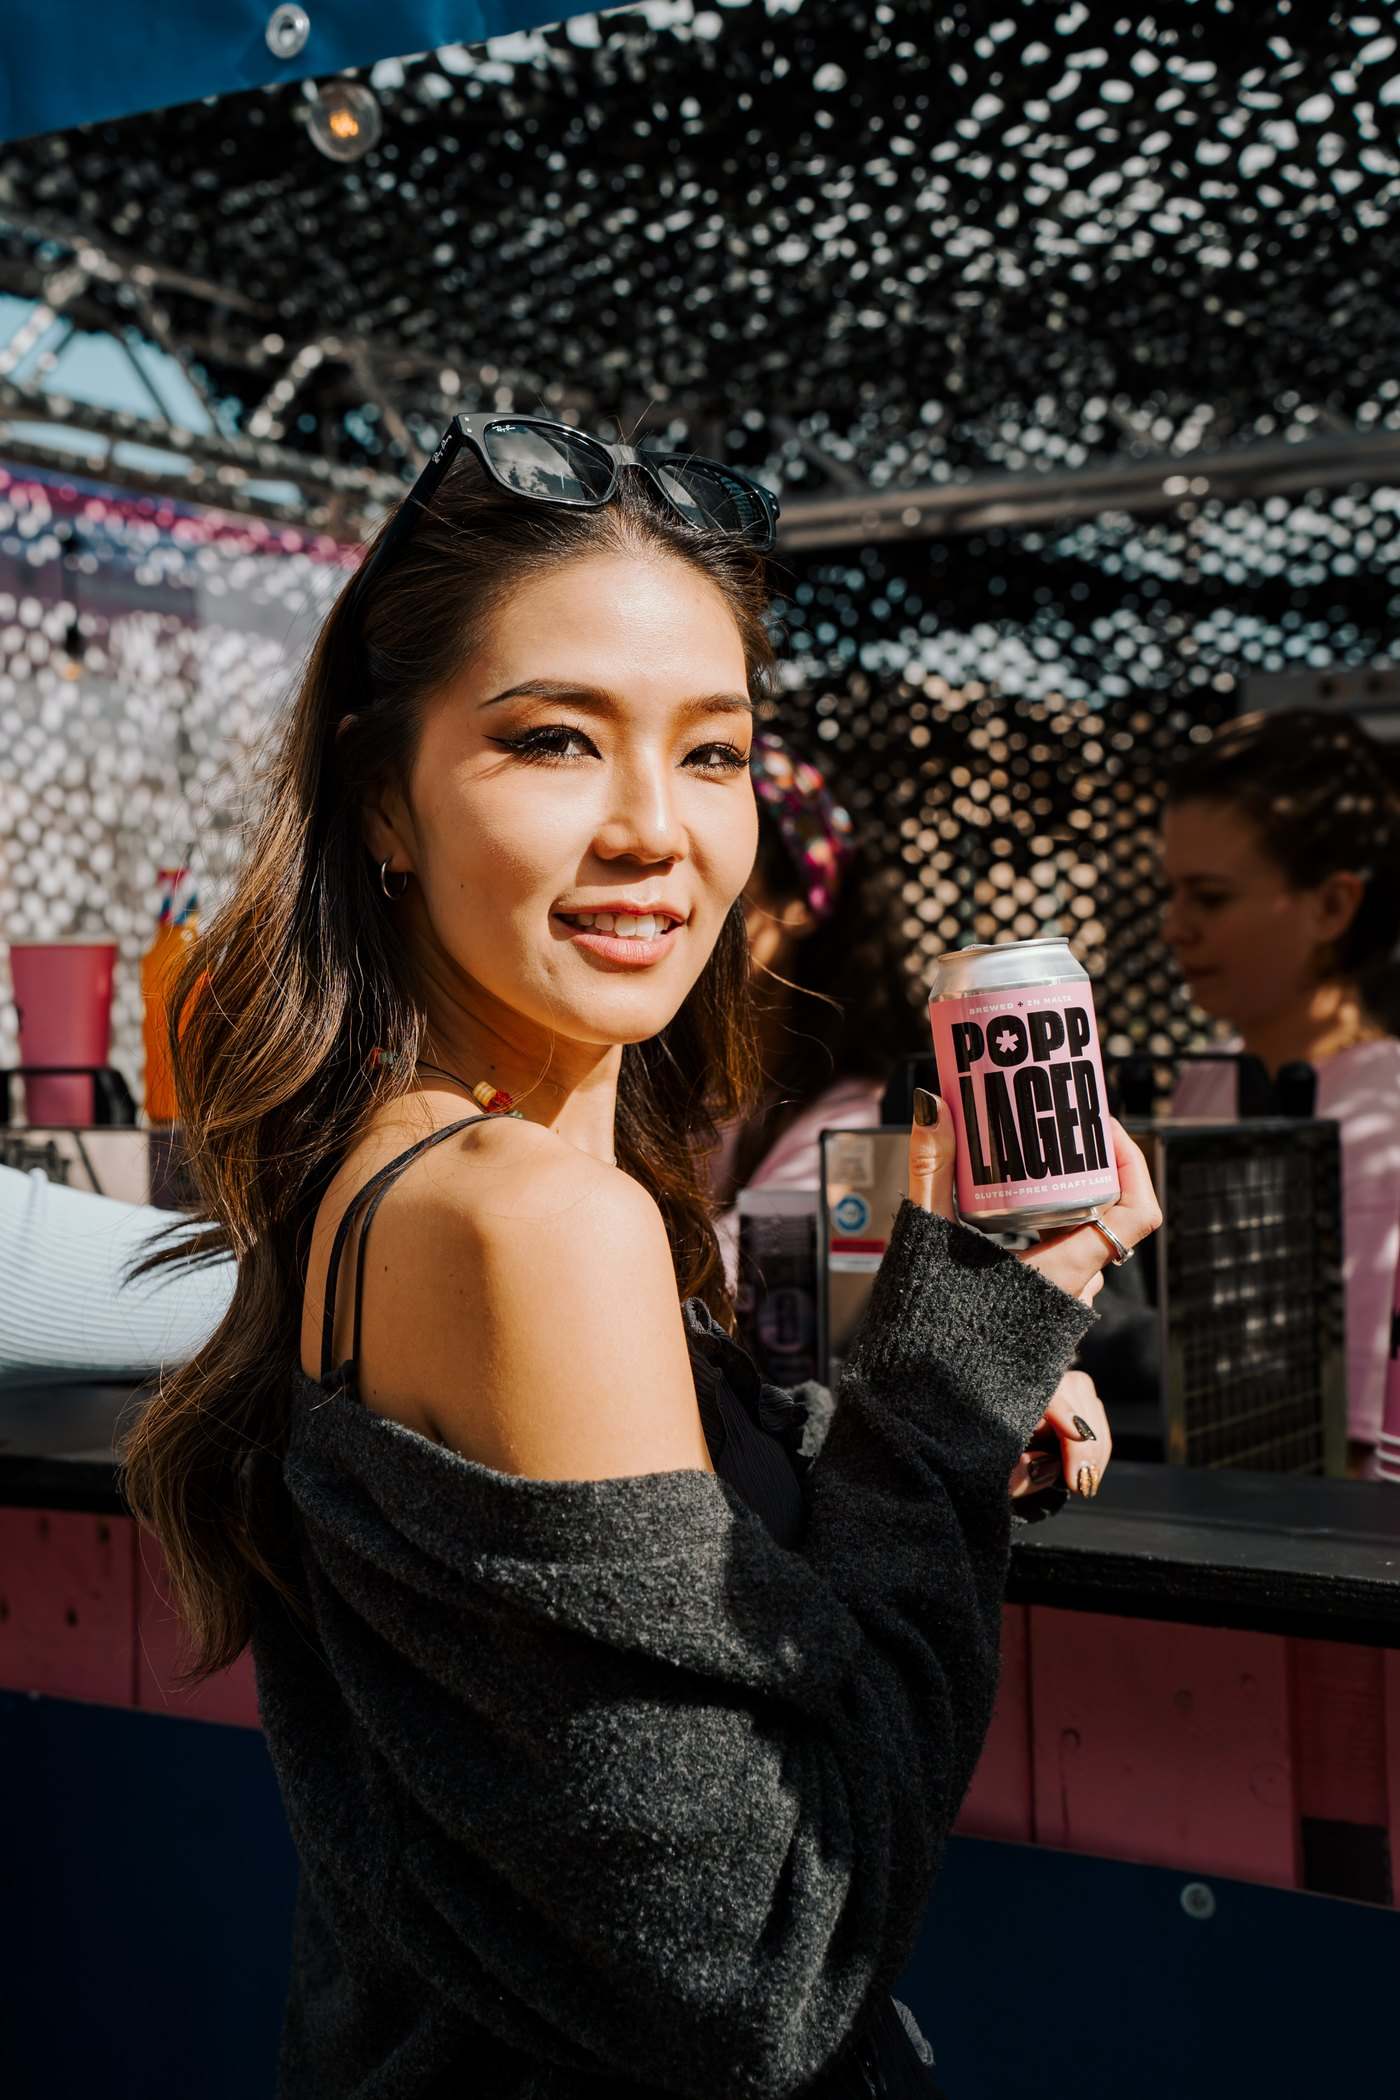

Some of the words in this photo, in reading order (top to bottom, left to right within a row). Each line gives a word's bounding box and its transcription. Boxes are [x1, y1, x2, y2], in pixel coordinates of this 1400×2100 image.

[969, 1002, 1014, 1016] BREWED
[951, 1006, 1091, 1074] POPP
[959, 1059, 1110, 1187] LAGER
[974, 1184, 1049, 1200] GLUTEN-FREE
[1051, 1179, 1086, 1192] CRAFT
